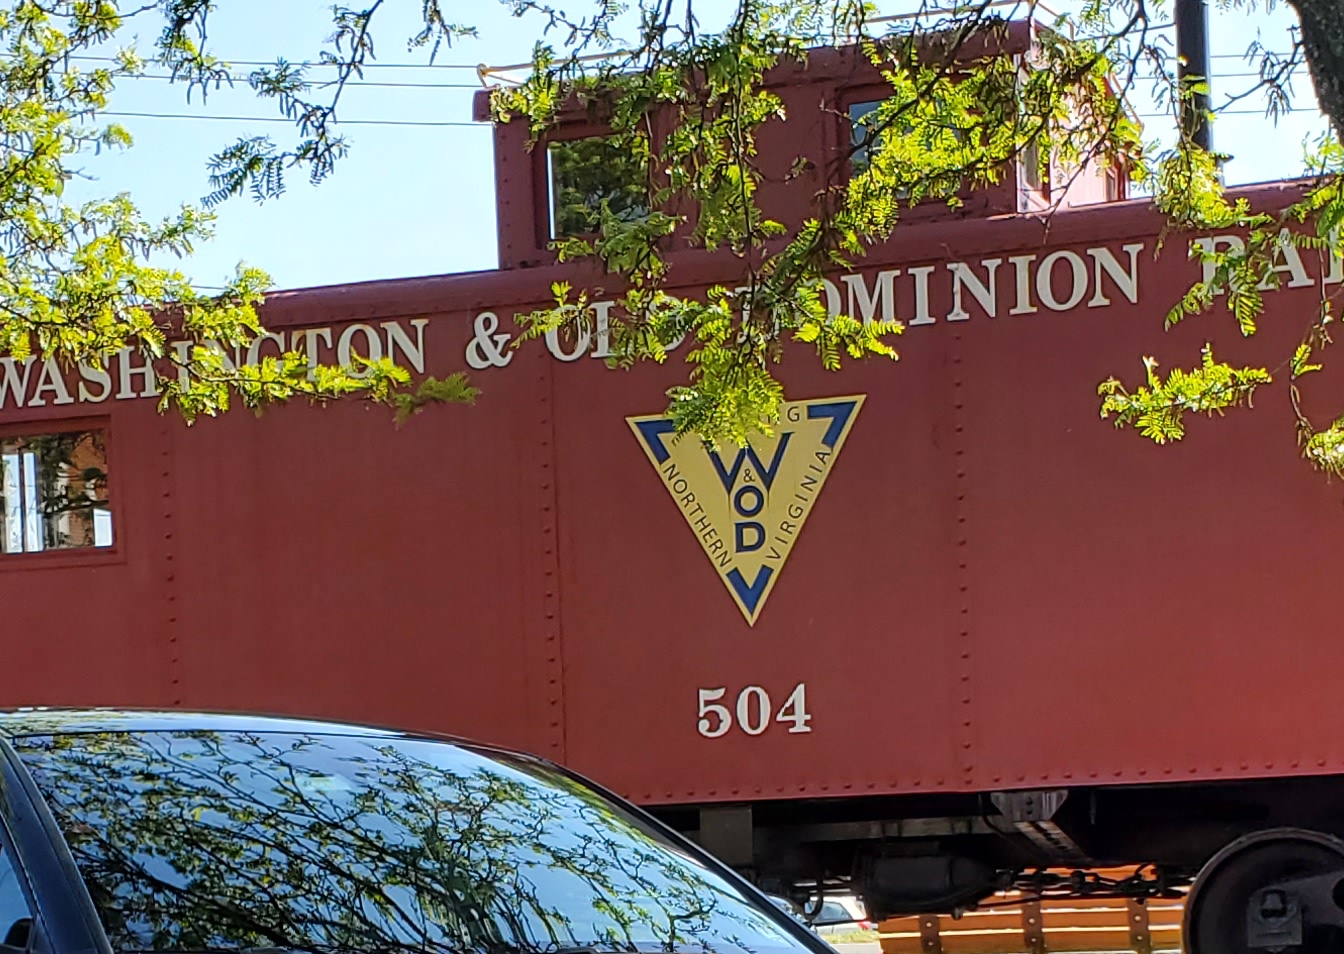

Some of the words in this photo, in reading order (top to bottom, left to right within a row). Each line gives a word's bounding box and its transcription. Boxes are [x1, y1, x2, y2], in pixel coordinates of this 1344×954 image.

[465, 311, 515, 370] &
[663, 463, 733, 568] NORTHERN
[765, 449, 832, 561] VIRGINIA
[696, 683, 813, 738] 504
